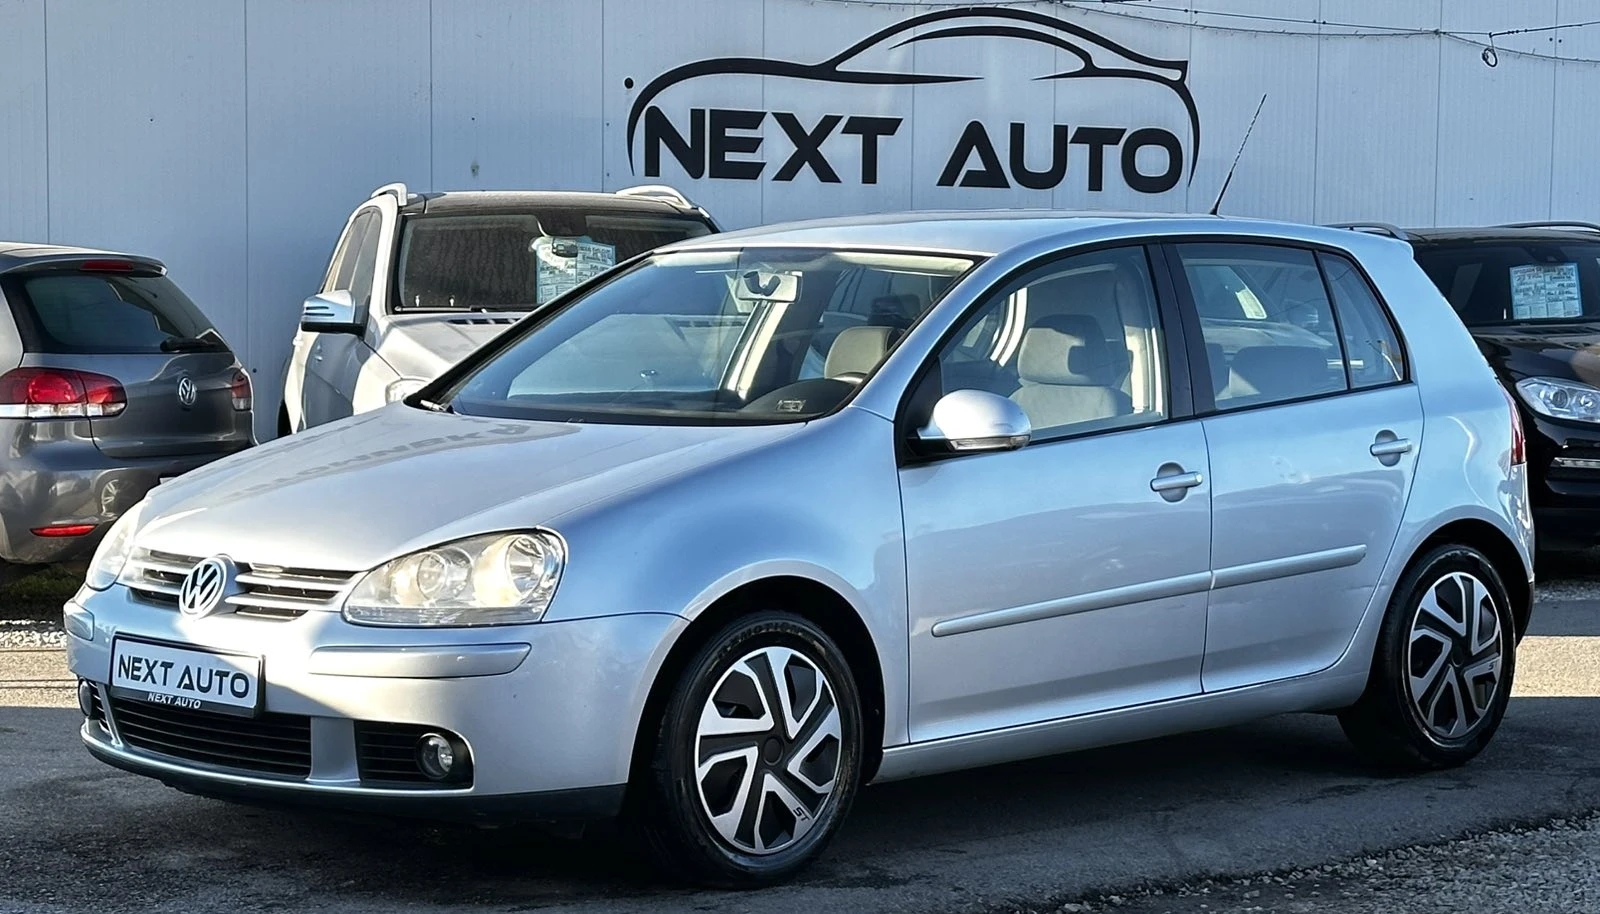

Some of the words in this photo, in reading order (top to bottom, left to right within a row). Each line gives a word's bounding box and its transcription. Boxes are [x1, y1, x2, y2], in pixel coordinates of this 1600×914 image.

[645, 105, 903, 184] NEXT
[936, 120, 1183, 194] AUTO
[181, 559, 224, 615] VW
[118, 654, 174, 686] NEXT
[176, 665, 249, 698] AUTO
[148, 692, 174, 705] NEXT
[174, 697, 201, 709] AUTO
[792, 807, 811, 821] ST
